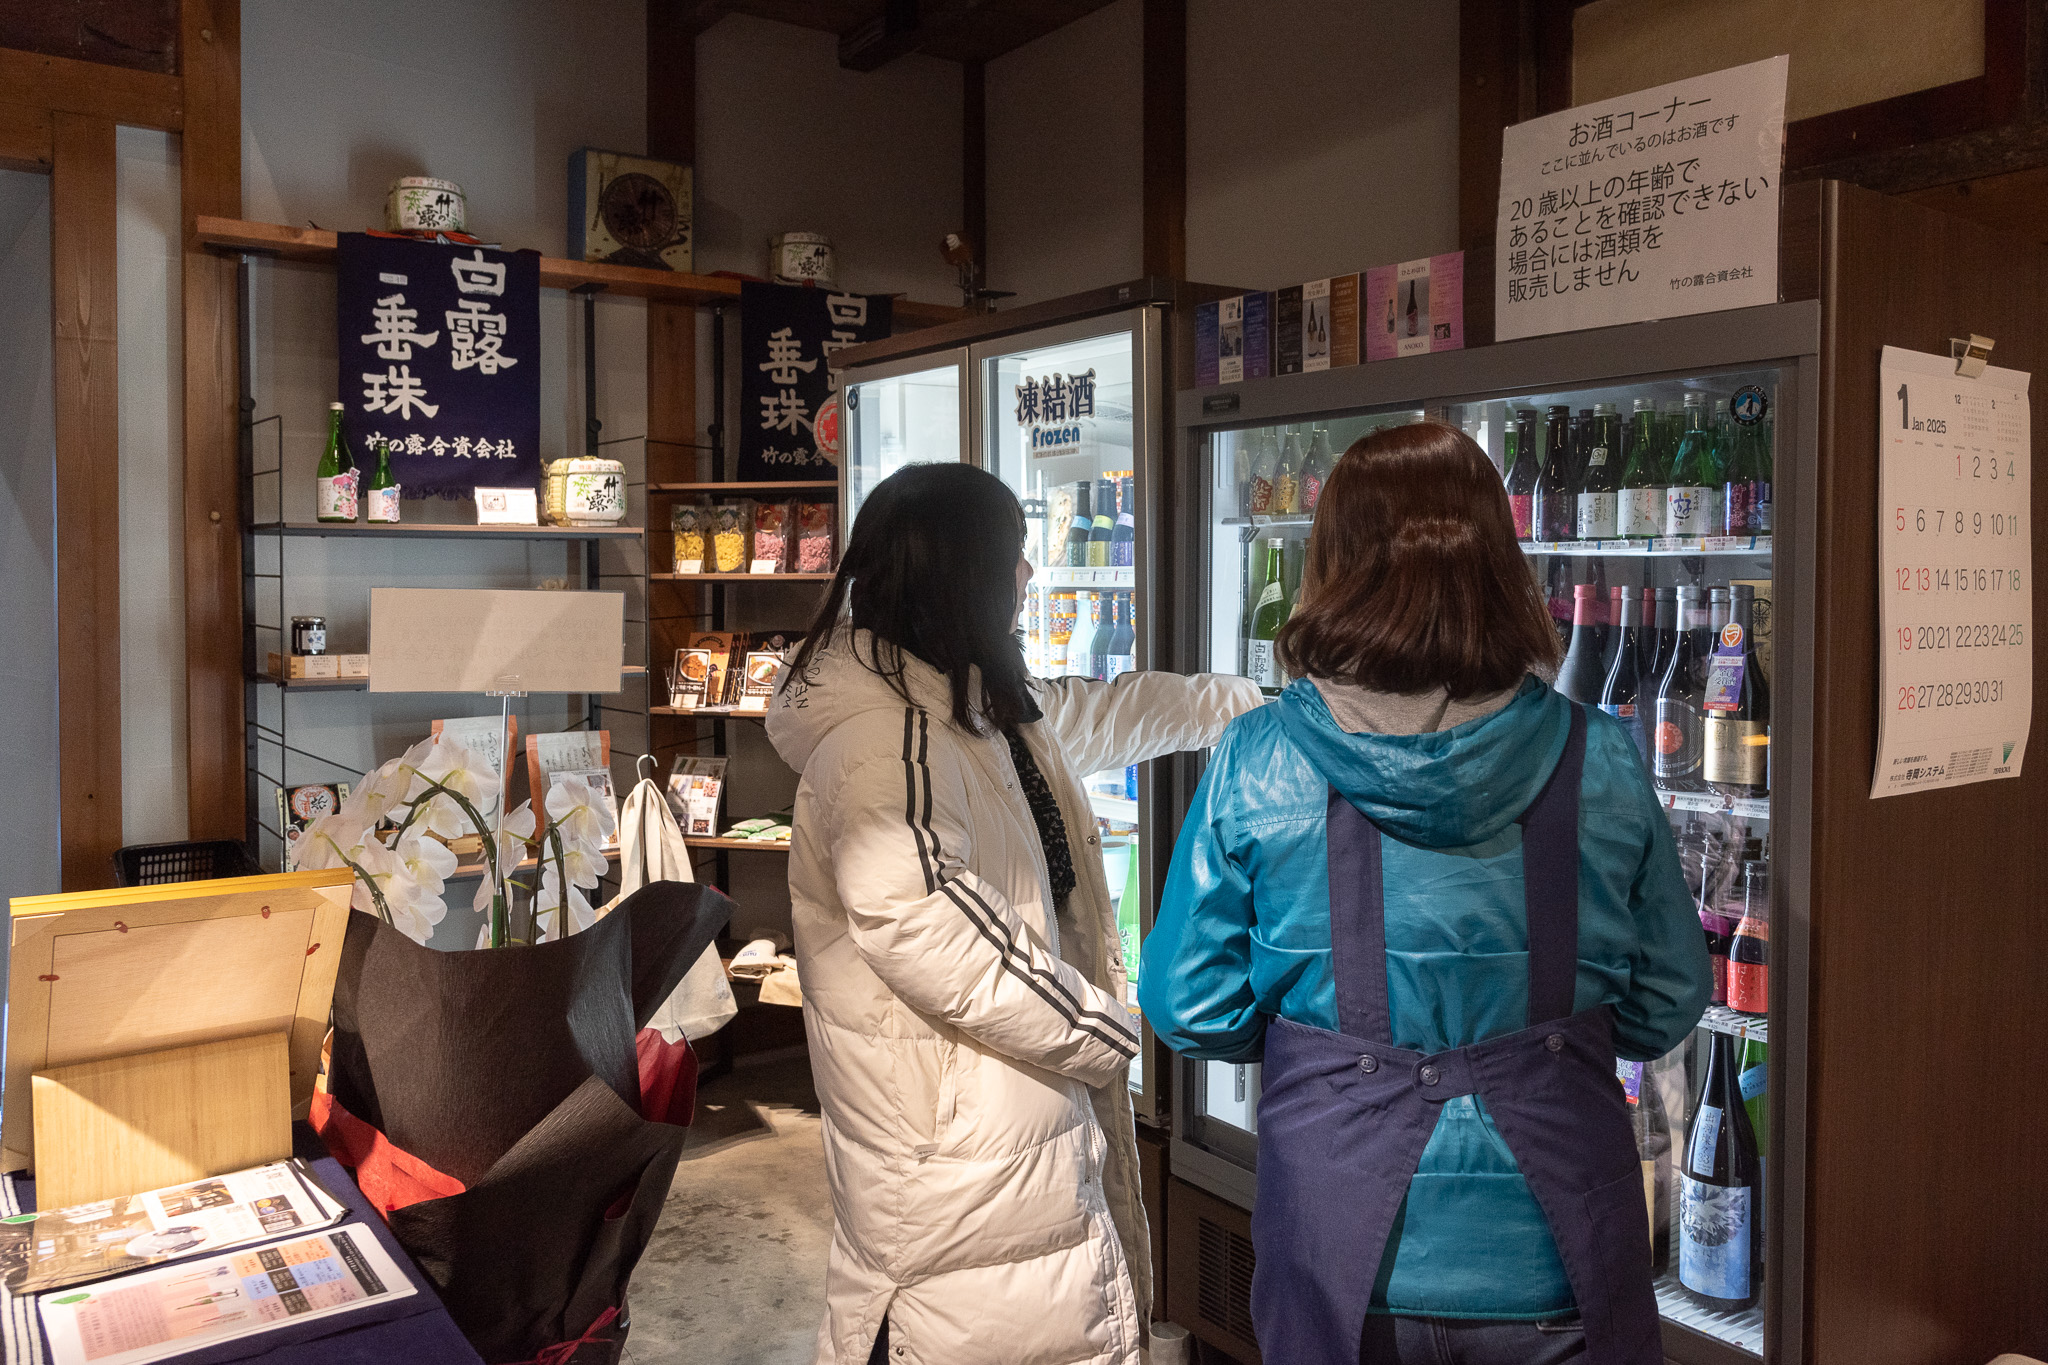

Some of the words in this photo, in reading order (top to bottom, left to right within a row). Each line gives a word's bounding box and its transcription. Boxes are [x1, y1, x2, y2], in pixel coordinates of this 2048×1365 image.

[1568, 95, 1712, 149] お酒コーナー
[1540, 113, 1740, 176] ここに並んでいるのはお酒です
[1508, 174, 1769, 250] あることを確認できない
[1508, 225, 1664, 276] 場合には酒類を
[1507, 259, 1640, 305] 販売しません
[1669, 265, 1754, 291] 竹の露合資会社
[1016, 370, 1095, 424] 凍結酒
[1896, 383, 1909, 430] 1
[1911, 416, 1925, 431] Jan
[1926, 418, 1947, 434] 2025
[364, 431, 518, 460] 竹の露合資会社
[1956, 454, 1961, 477] 1
[1972, 455, 1981, 478] 2
[1990, 457, 1998, 480] 3
[2006, 460, 2015, 482] 4
[1896, 507, 1905, 532] 5
[1916, 508, 1926, 532] 6
[1936, 510, 1945, 533] 7
[1955, 511, 1964, 534] 8
[1973, 512, 1982, 535] 9
[1990, 513, 2004, 536] 10
[2008, 514, 2017, 536] 11
[1895, 567, 1911, 591] 12
[1915, 567, 1930, 591] 13
[1935, 568, 1950, 591] 14
[1954, 568, 1968, 591] 15
[1972, 568, 1987, 591] 16
[1990, 569, 2004, 591] 17
[2007, 569, 2021, 591] 18
[1897, 626, 1912, 651] 19
[1917, 626, 1935, 650] 20
[1937, 626, 1950, 649] 21
[1955, 625, 1972, 648] 22
[1973, 624, 1990, 647] 23
[1991, 624, 2007, 646] 24
[2008, 624, 2023, 646] 25
[1898, 686, 1916, 710] 26
[1917, 684, 1935, 709] 27
[1936, 683, 1954, 707] 28
[1955, 682, 1972, 705] 29
[1973, 681, 1990, 704] 30
[1990, 680, 2003, 702] 31
